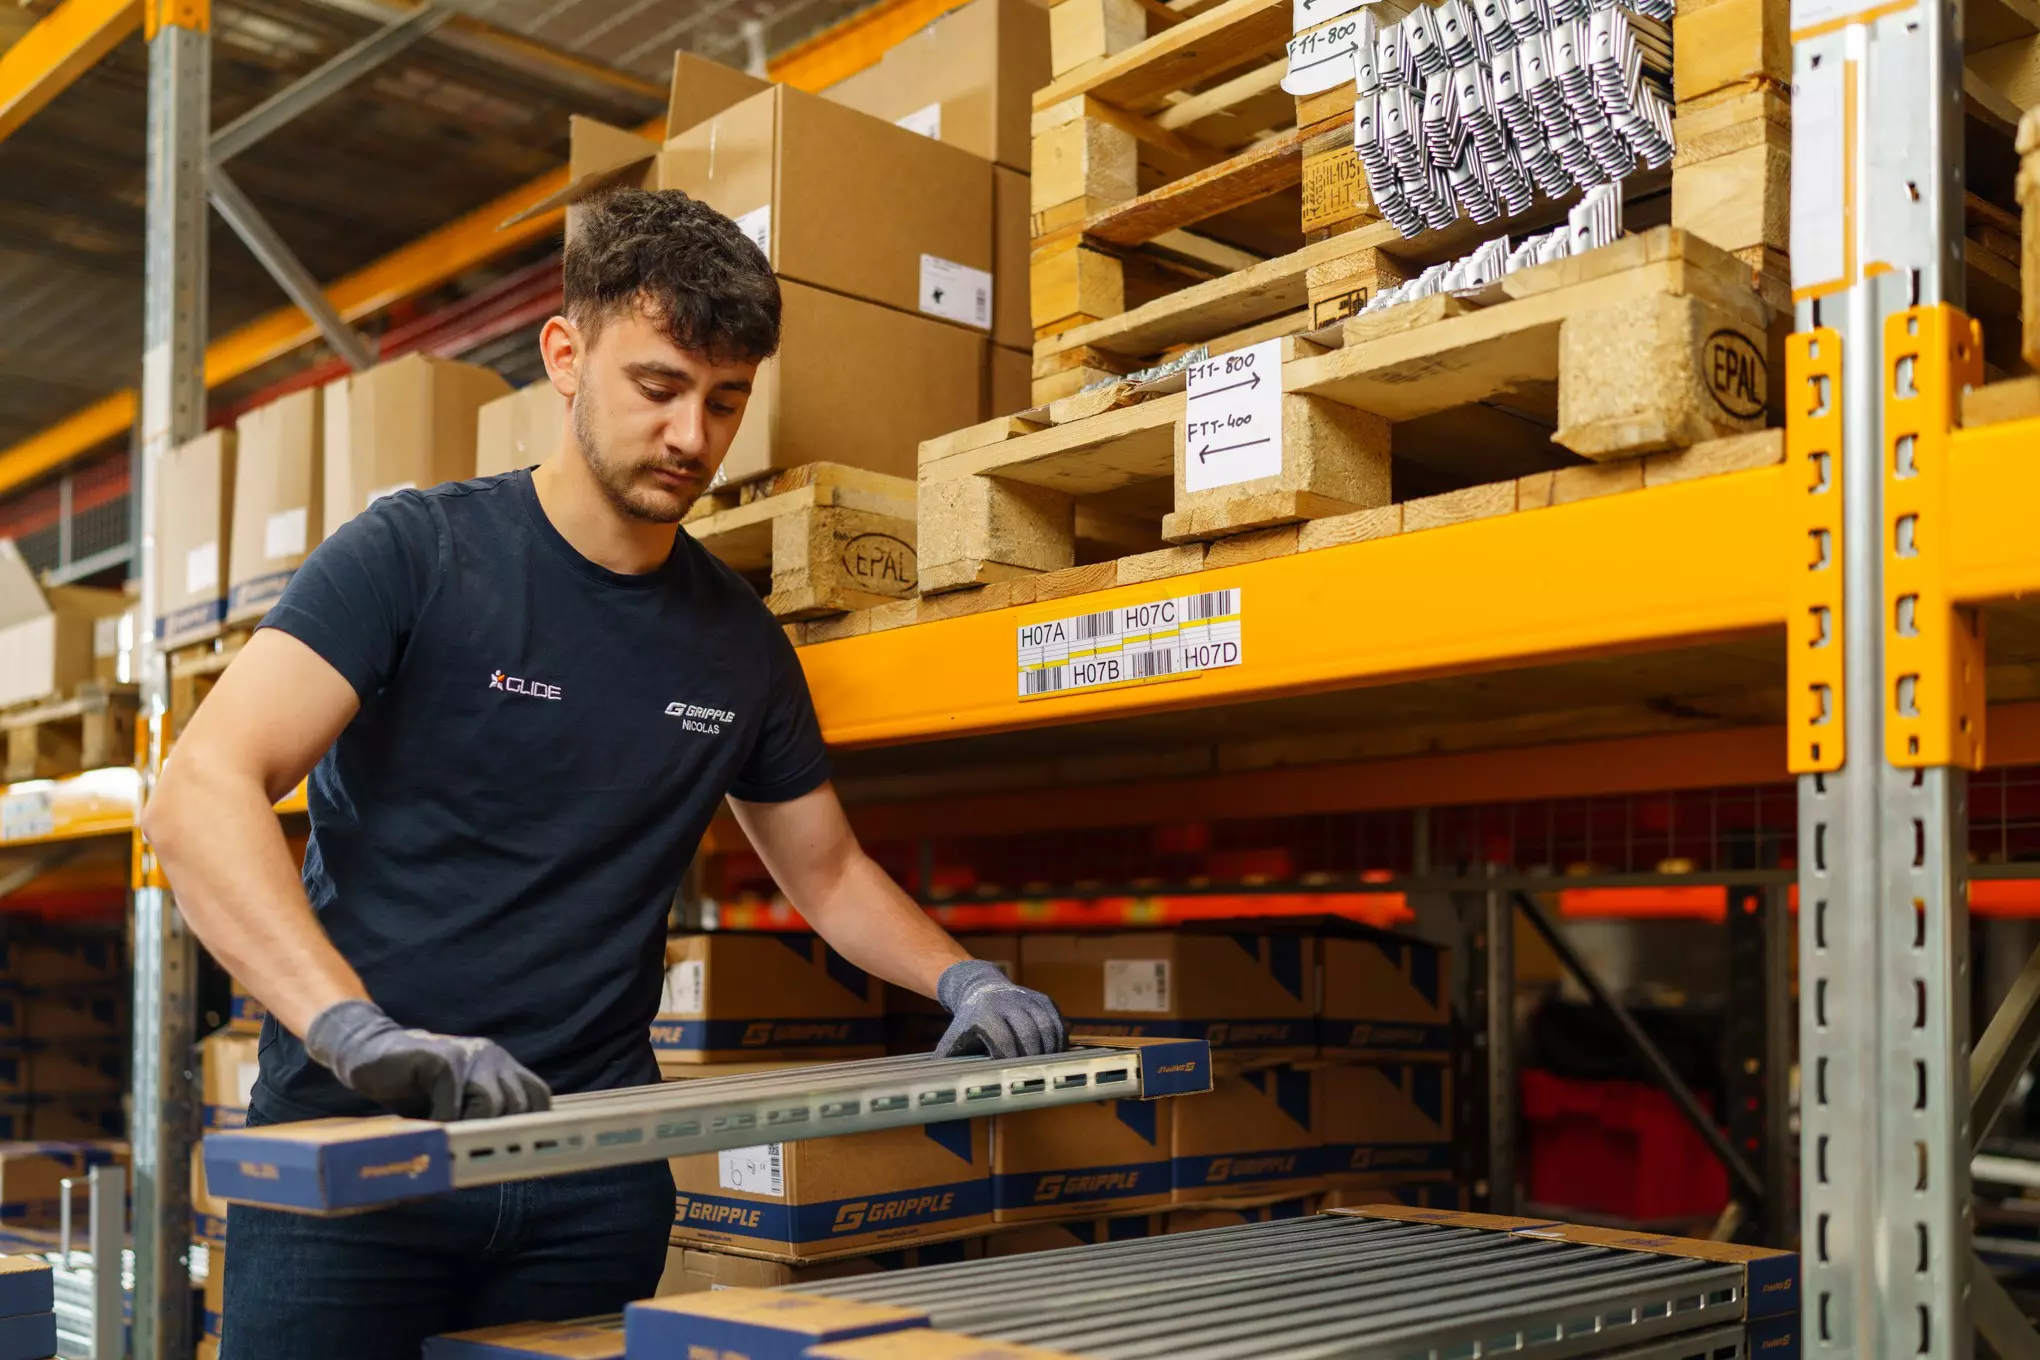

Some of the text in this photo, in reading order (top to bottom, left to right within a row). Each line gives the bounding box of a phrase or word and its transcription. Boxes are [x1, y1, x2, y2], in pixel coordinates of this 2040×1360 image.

[1188, 353, 1255, 387] FTT-800
[1714, 344, 1762, 406] EPAL
[1188, 414, 1252, 443] FTT-400
[856, 547, 910, 583] EPAL
[1126, 602, 1175, 629] H07C
[1021, 622, 1066, 648] H07A
[1184, 641, 1238, 669] H07D
[1074, 660, 1120, 685] H07B
[506, 676, 562, 700] GLIDE
[682, 719, 720, 734] NICOLAS
[685, 704, 736, 723] GRIPPLE
[1064, 1171, 1140, 1195] GRIPPLE
[688, 1201, 761, 1228] GRIPPLE
[867, 1192, 955, 1223] GRIPPLE
